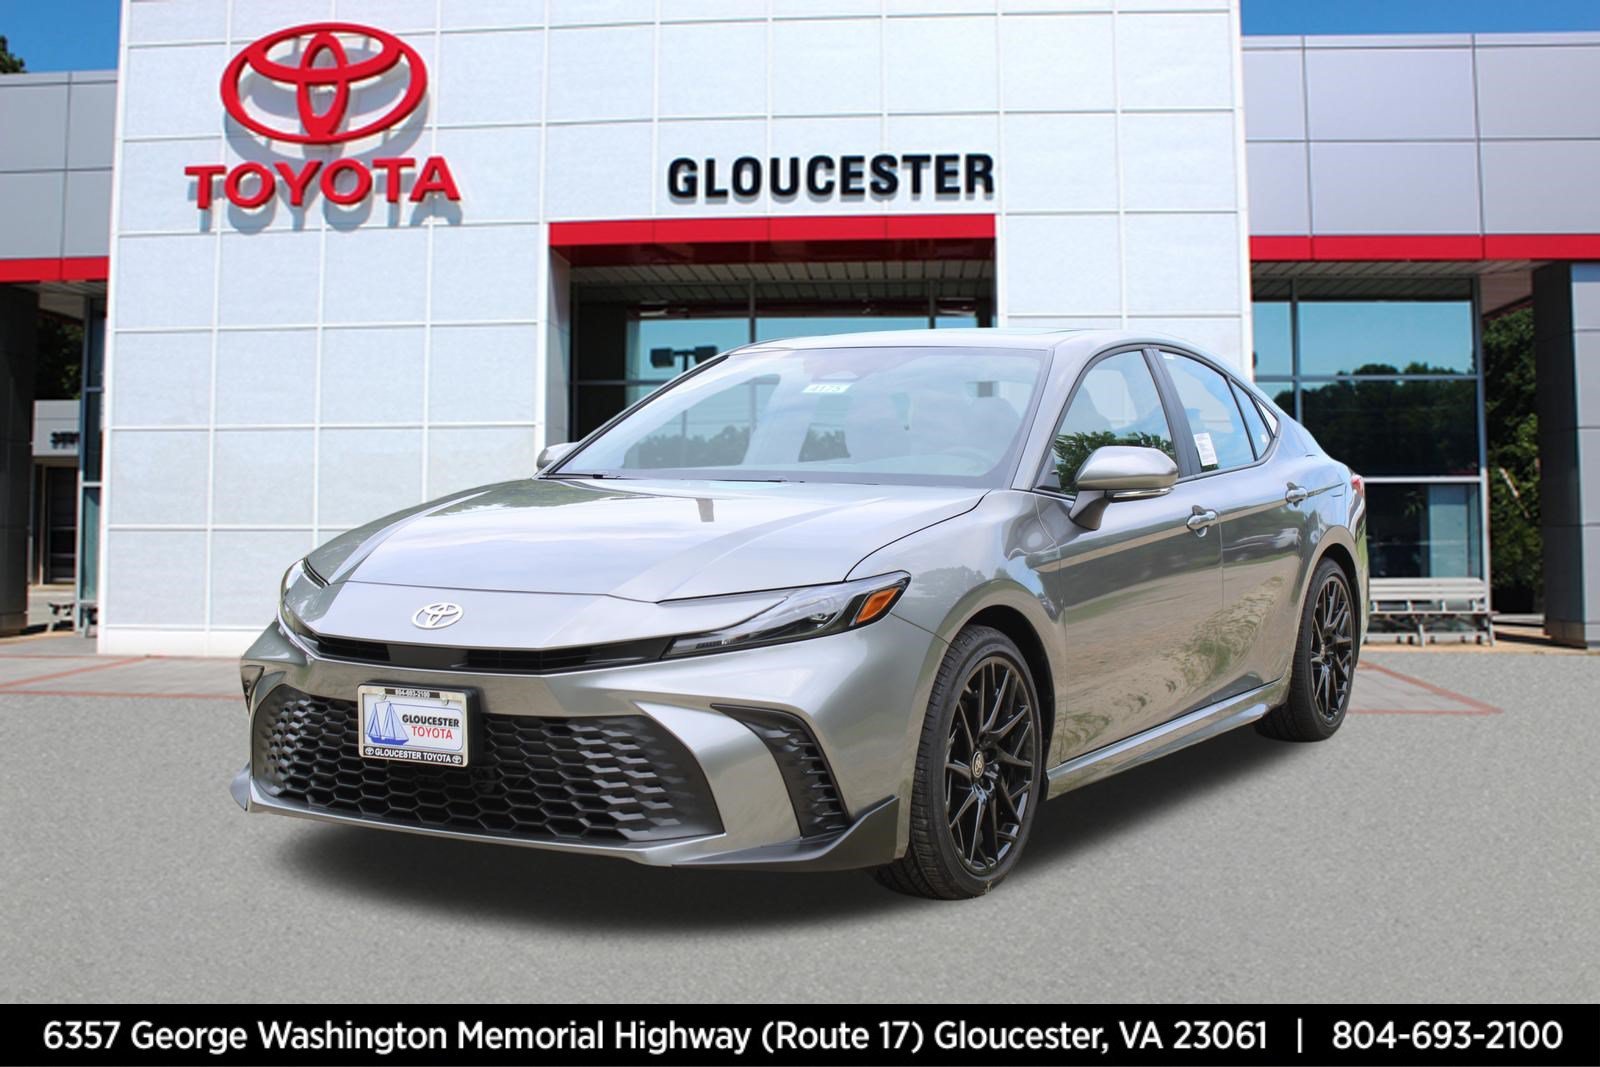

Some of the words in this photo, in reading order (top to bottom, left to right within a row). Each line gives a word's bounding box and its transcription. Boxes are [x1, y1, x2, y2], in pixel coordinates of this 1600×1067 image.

[185, 156, 461, 209] TOYOTA
[668, 154, 994, 199] GLOUCESTER
[402, 714, 460, 727] GLOUCESTER
[411, 725, 453, 740] TOYOTA
[374, 747, 422, 760] GLOUCESTER
[423, 752, 452, 764] TOYOTA
